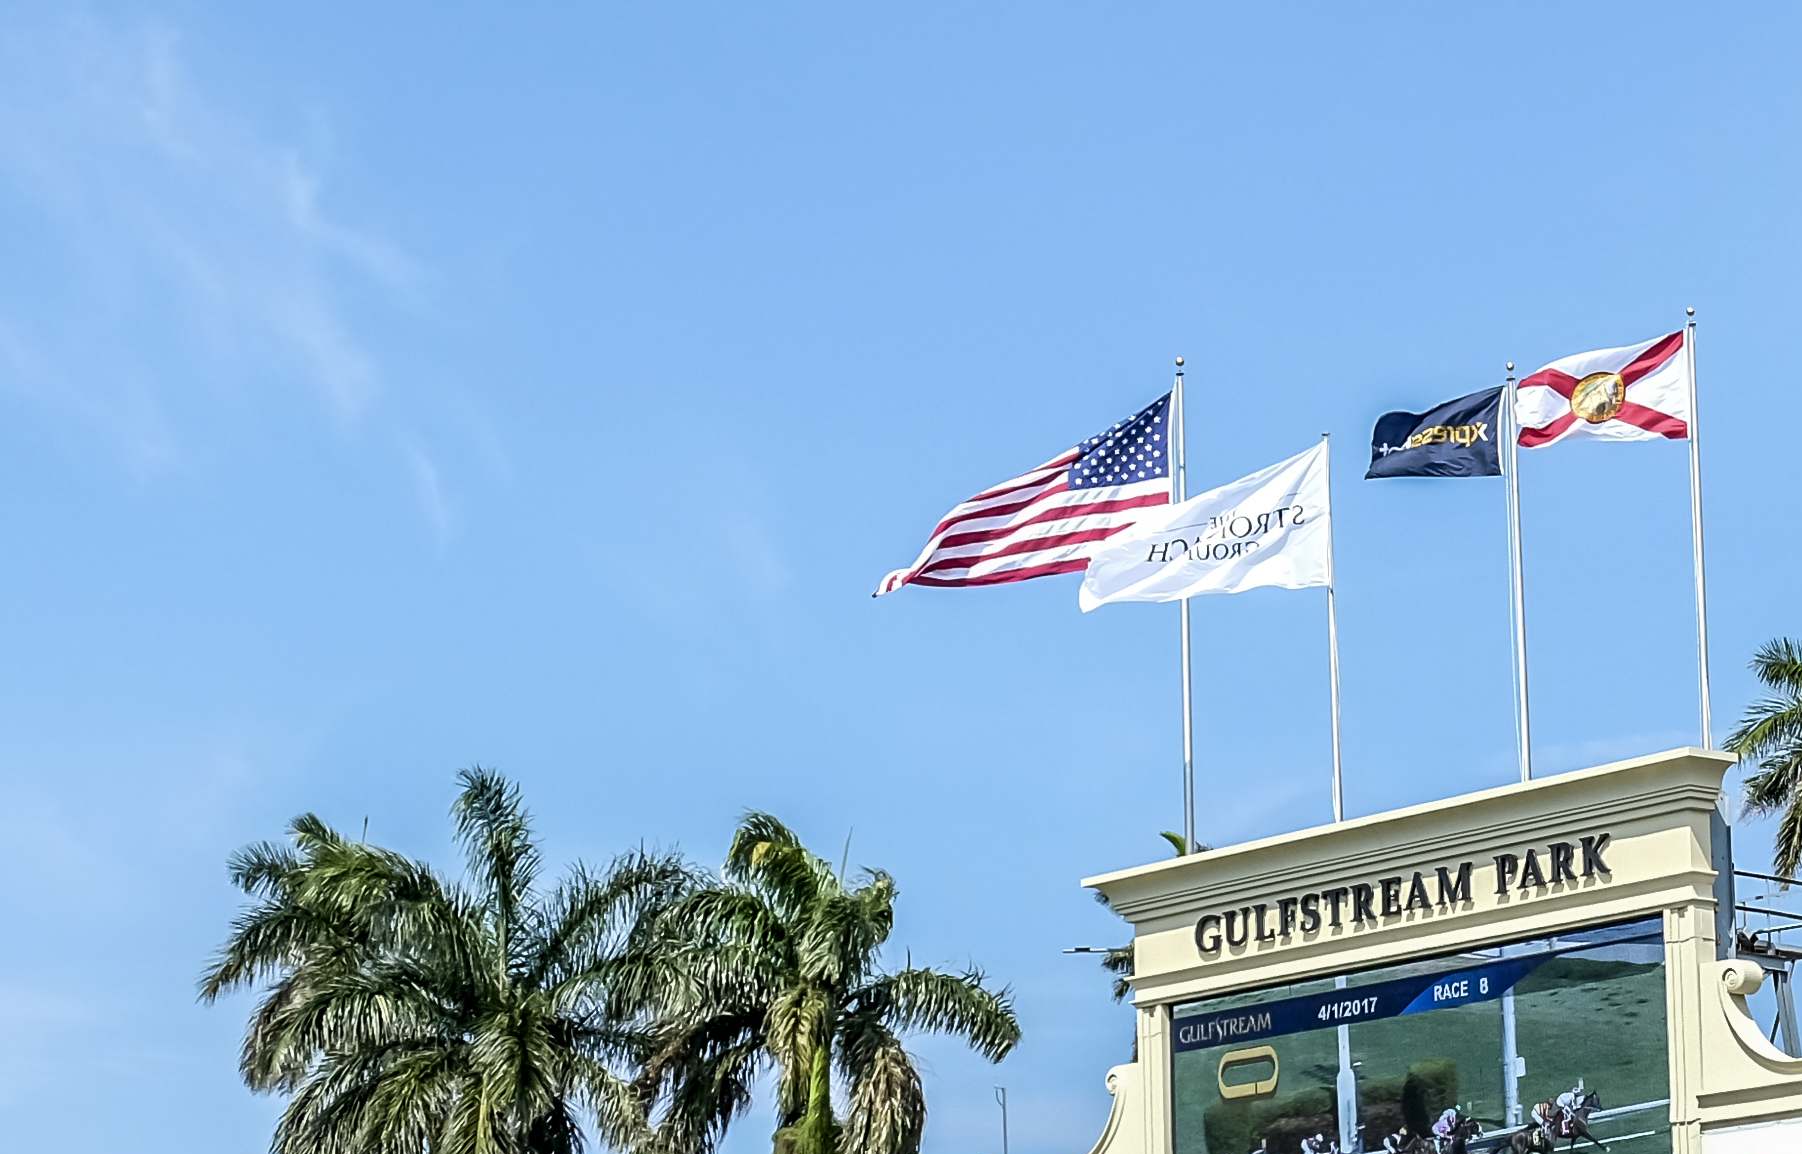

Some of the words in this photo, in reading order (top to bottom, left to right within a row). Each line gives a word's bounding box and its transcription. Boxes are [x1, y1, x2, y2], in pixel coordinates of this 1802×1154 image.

[1195, 861, 1475, 953] GULFSTREAM
[1493, 833, 1612, 895] PARK
[1433, 980, 1469, 1001] RACE
[1479, 977, 1489, 995] 8
[1317, 997, 1378, 1021] 4/1/2017
[1179, 1012, 1273, 1044] GULFSTREAM
